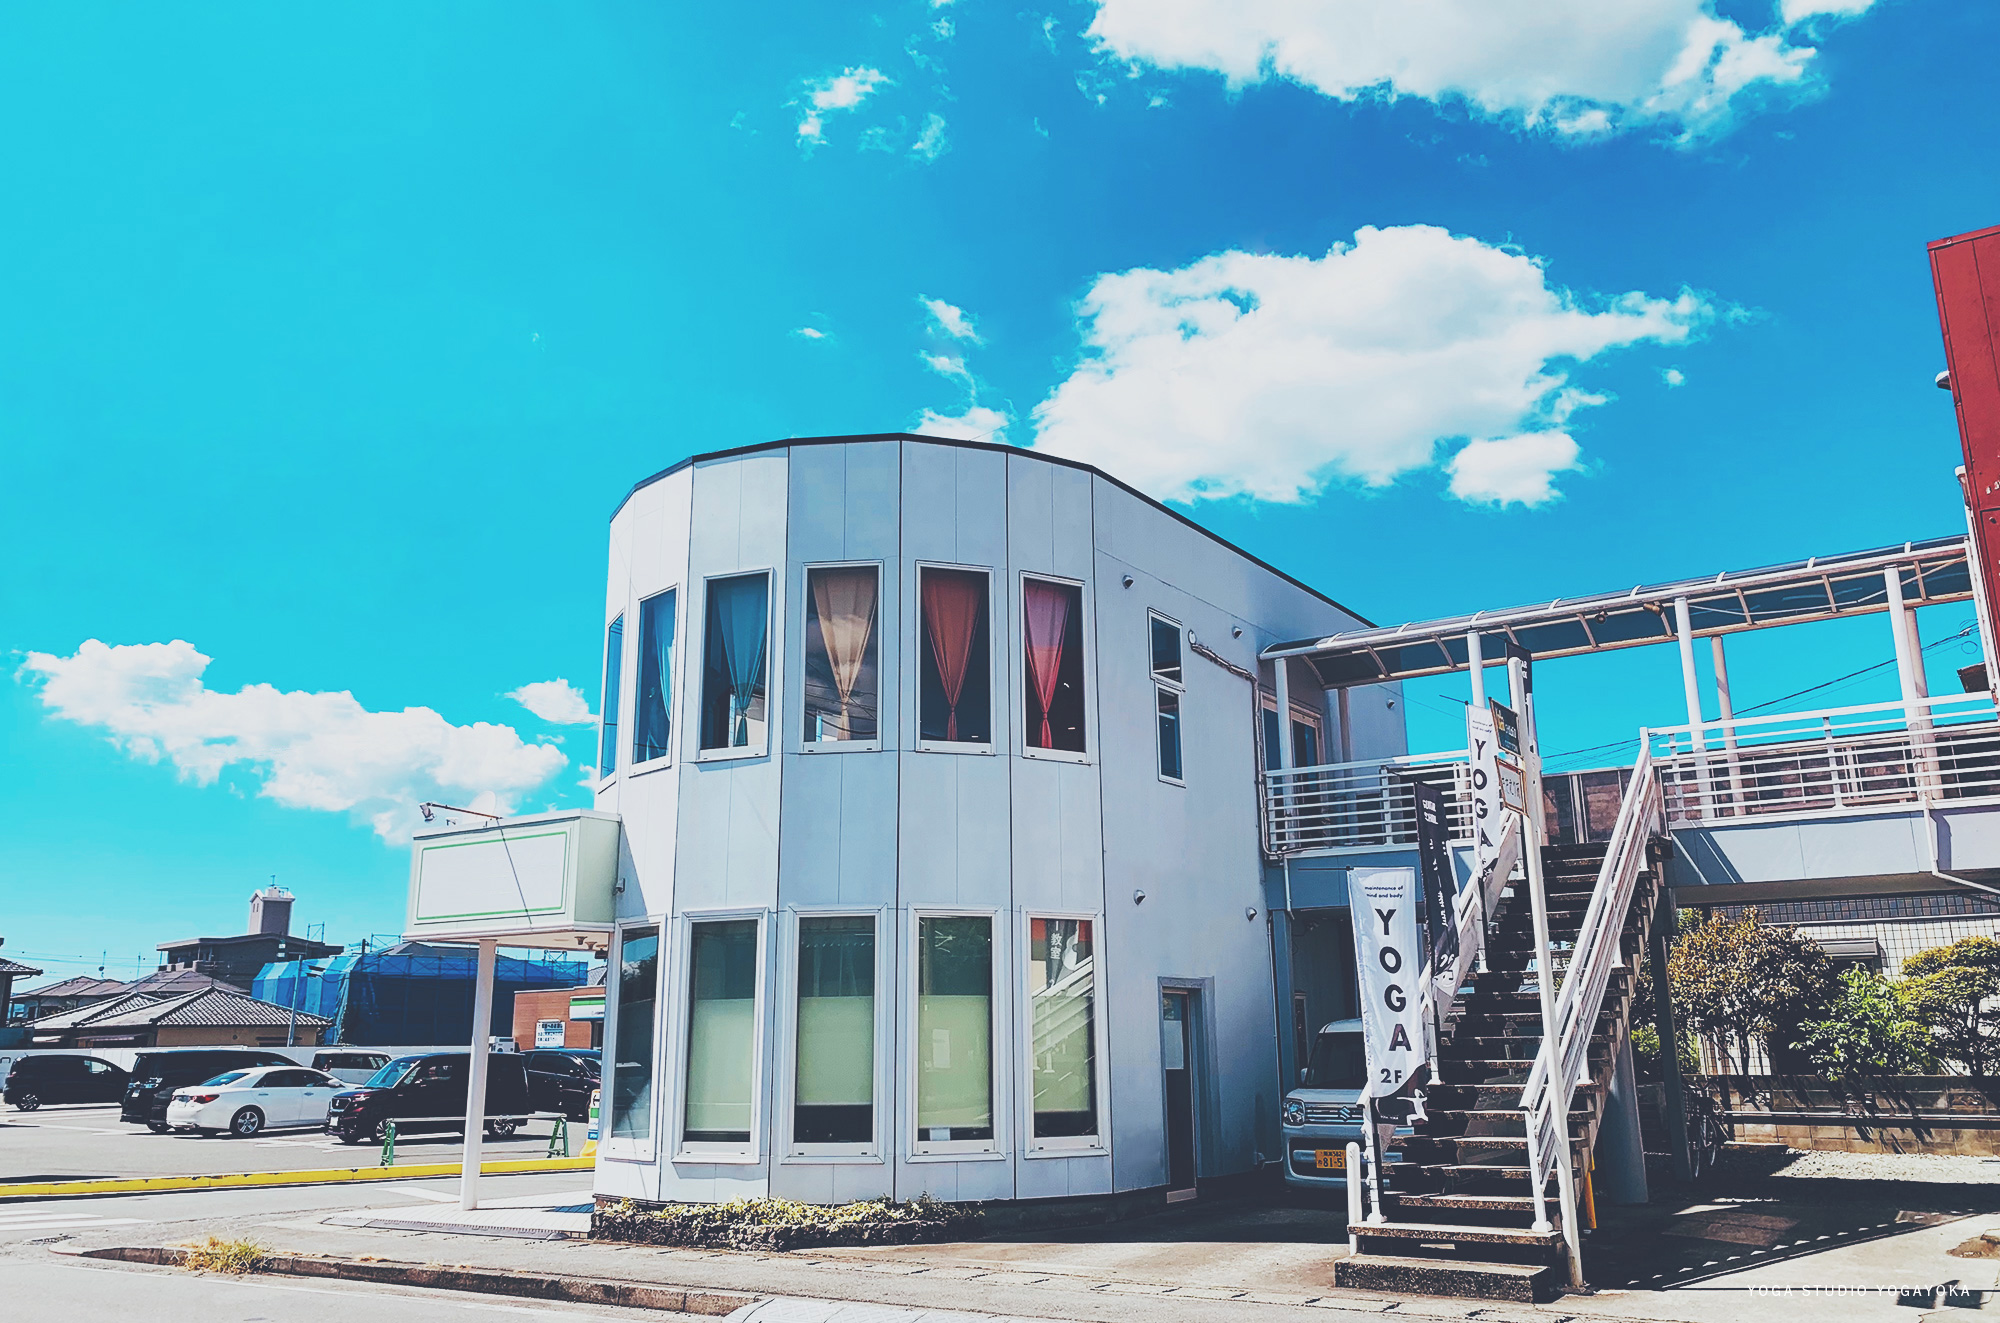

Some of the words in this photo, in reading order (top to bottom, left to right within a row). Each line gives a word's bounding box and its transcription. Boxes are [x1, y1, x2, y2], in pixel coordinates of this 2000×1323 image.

[1473, 738, 1493, 847] YOGA
[1374, 908, 1412, 1051] YOGA
[1380, 1068, 1403, 1083] 2F
